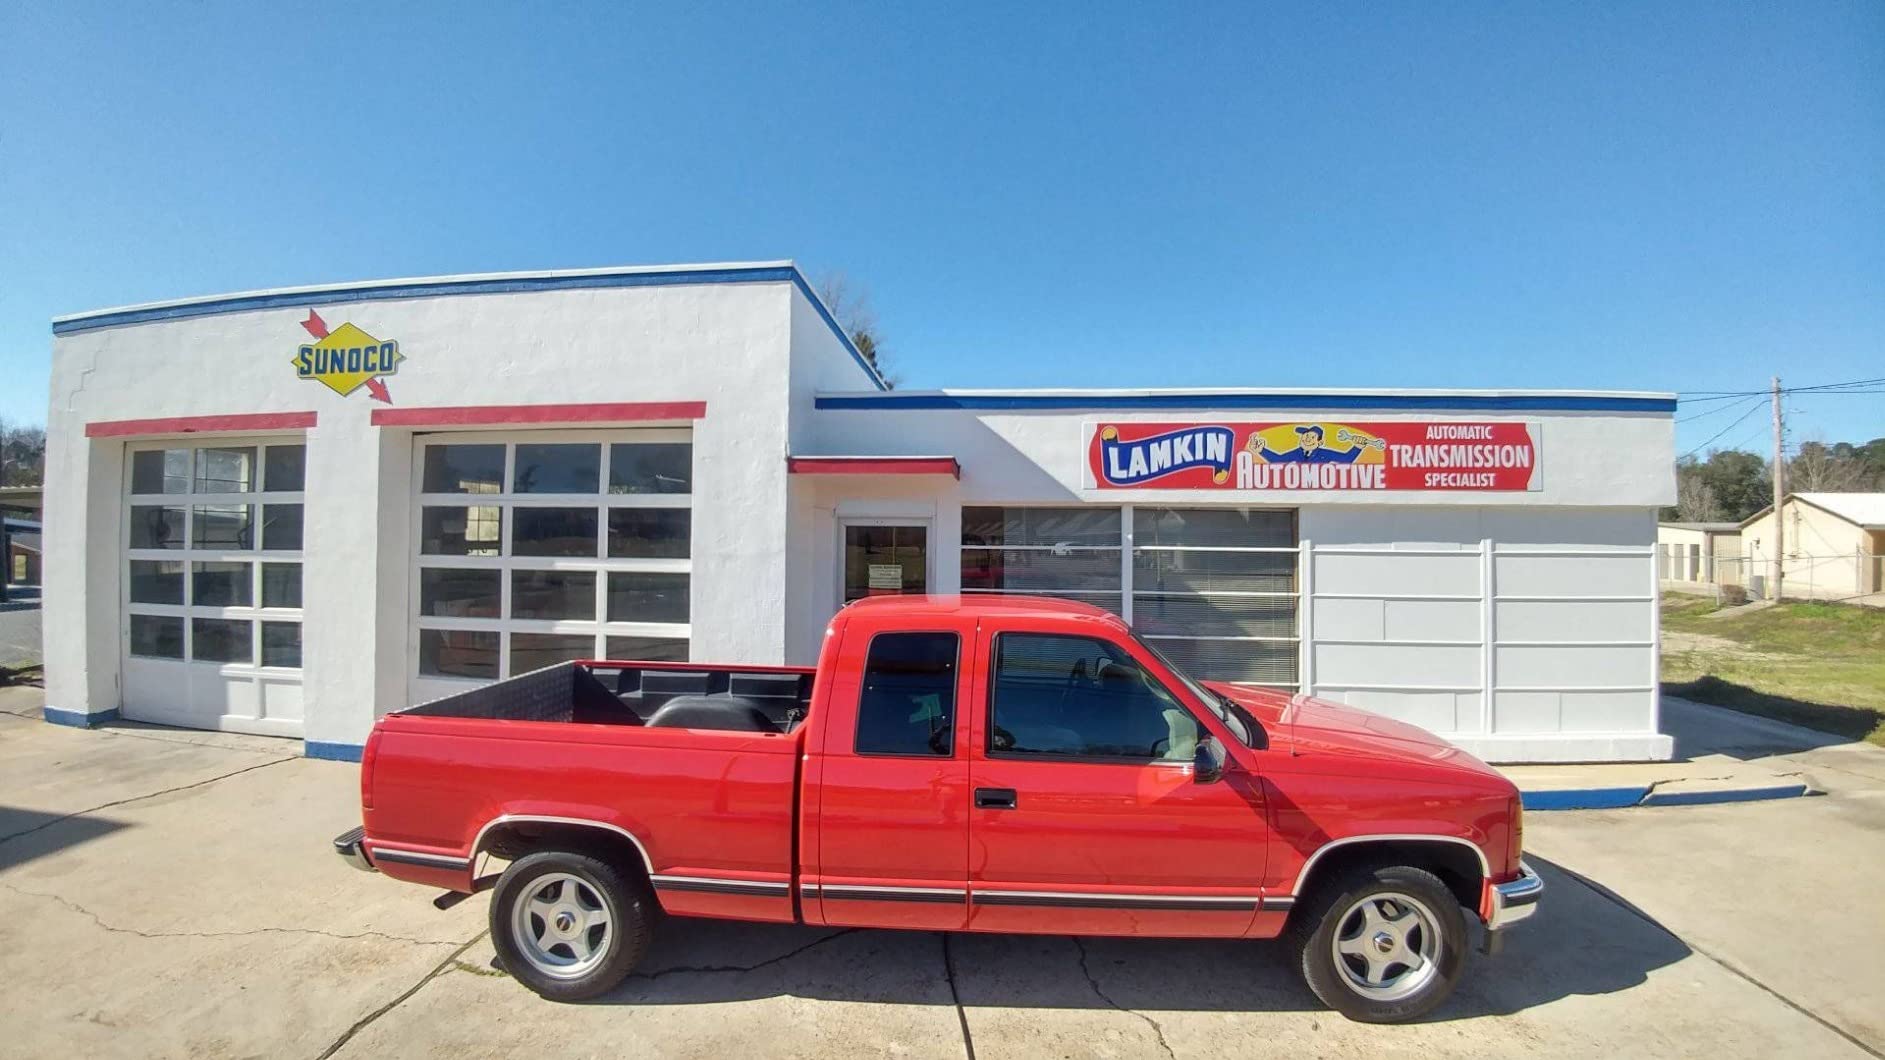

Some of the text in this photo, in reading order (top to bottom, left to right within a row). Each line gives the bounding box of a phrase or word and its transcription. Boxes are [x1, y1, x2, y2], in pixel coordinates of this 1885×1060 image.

[300, 342, 394, 375] SUNOCO
[1426, 425, 1494, 440] AUTOMATIC
[1108, 432, 1386, 489] LAMKIN AUTOMOTIVE
[1389, 444, 1530, 468] TRANSMISSION
[1424, 473, 1497, 487] SPECIALIST
